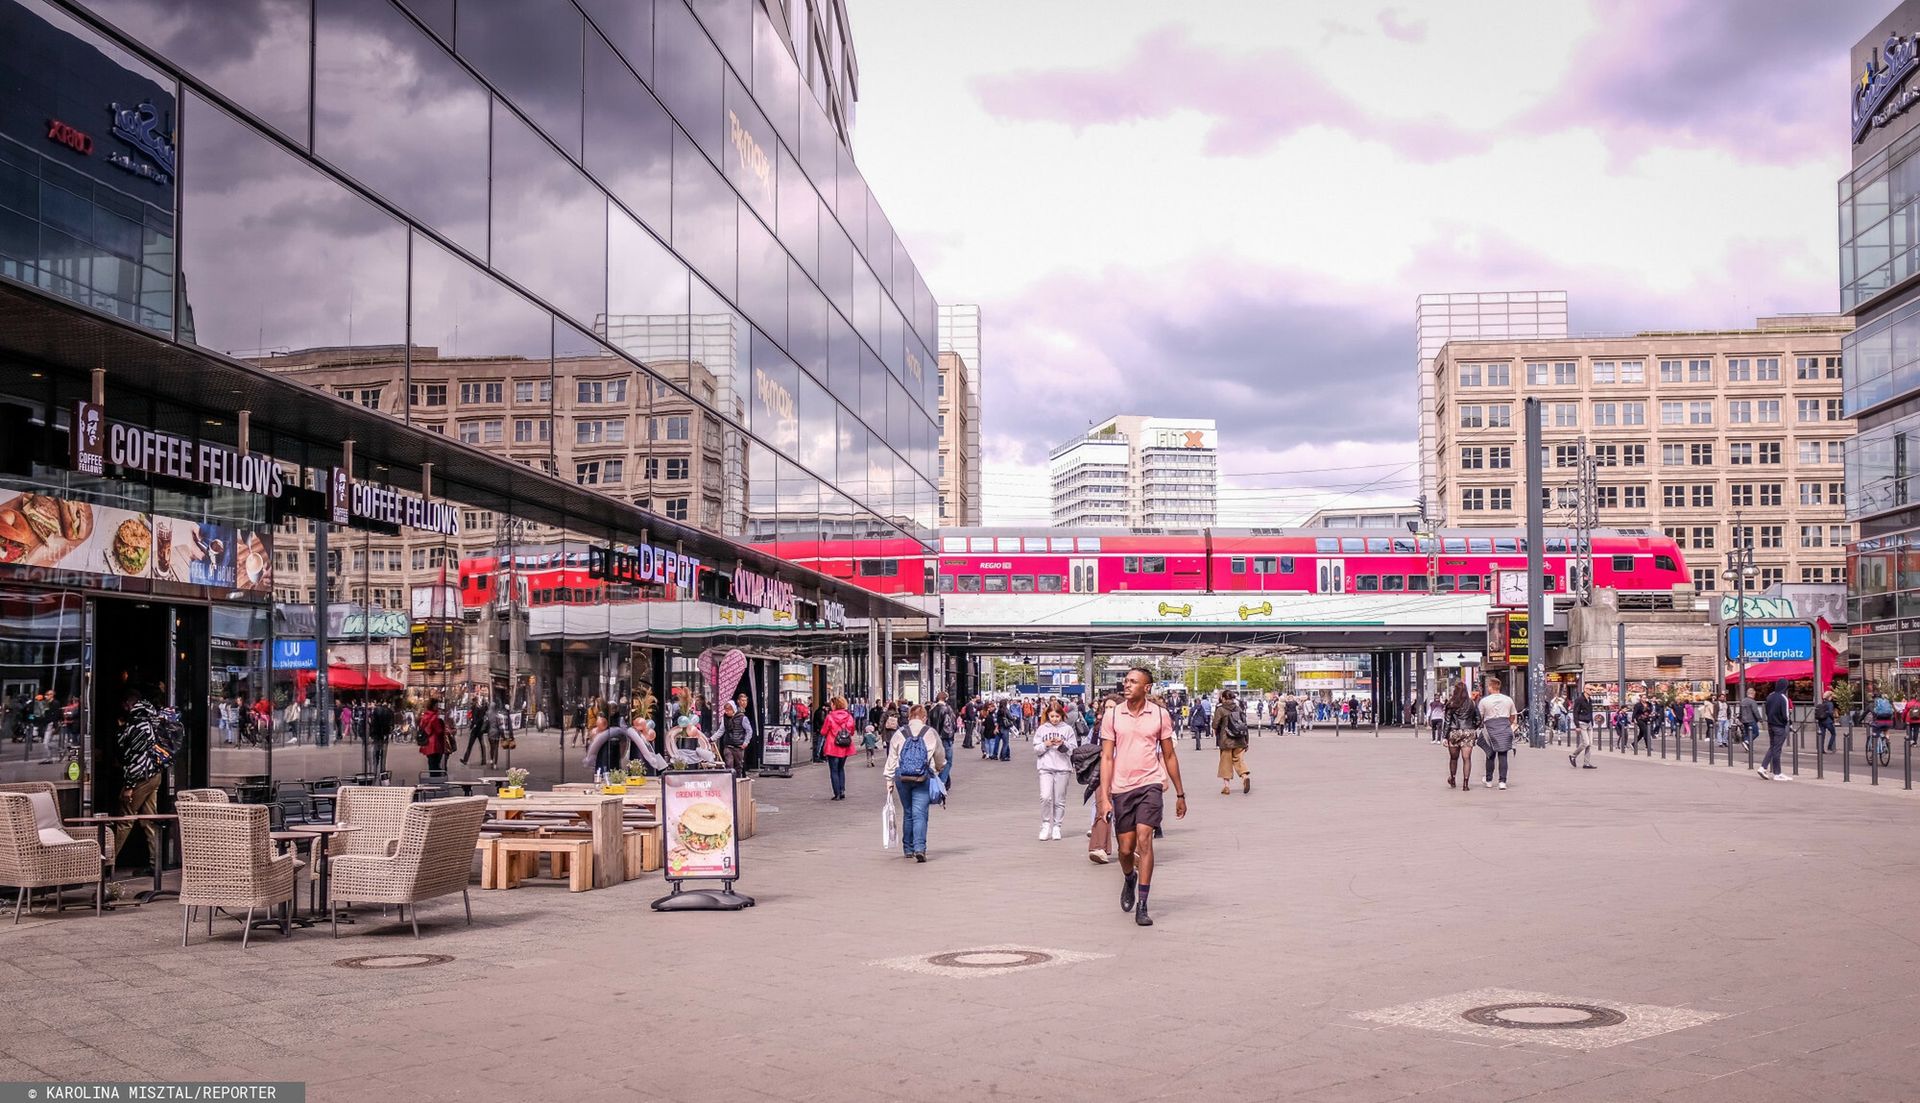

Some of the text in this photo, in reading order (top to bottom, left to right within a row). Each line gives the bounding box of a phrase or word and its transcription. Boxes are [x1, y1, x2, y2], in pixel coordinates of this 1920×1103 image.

[79, 452, 102, 466] COFFEE
[110, 423, 283, 499] COFFEE FELLOWS
[79, 463, 102, 474] FELLOWS
[352, 482, 459, 536] COFFEE FELLOWS
[217, 565, 236, 583] HOME
[640, 543, 700, 600] DEPOT
[1763, 629, 1778, 646] U
[1734, 648, 1804, 659] lexanderplatz
[700, 780, 712, 788] NEW
[676, 790, 702, 798] ORIENTAL
